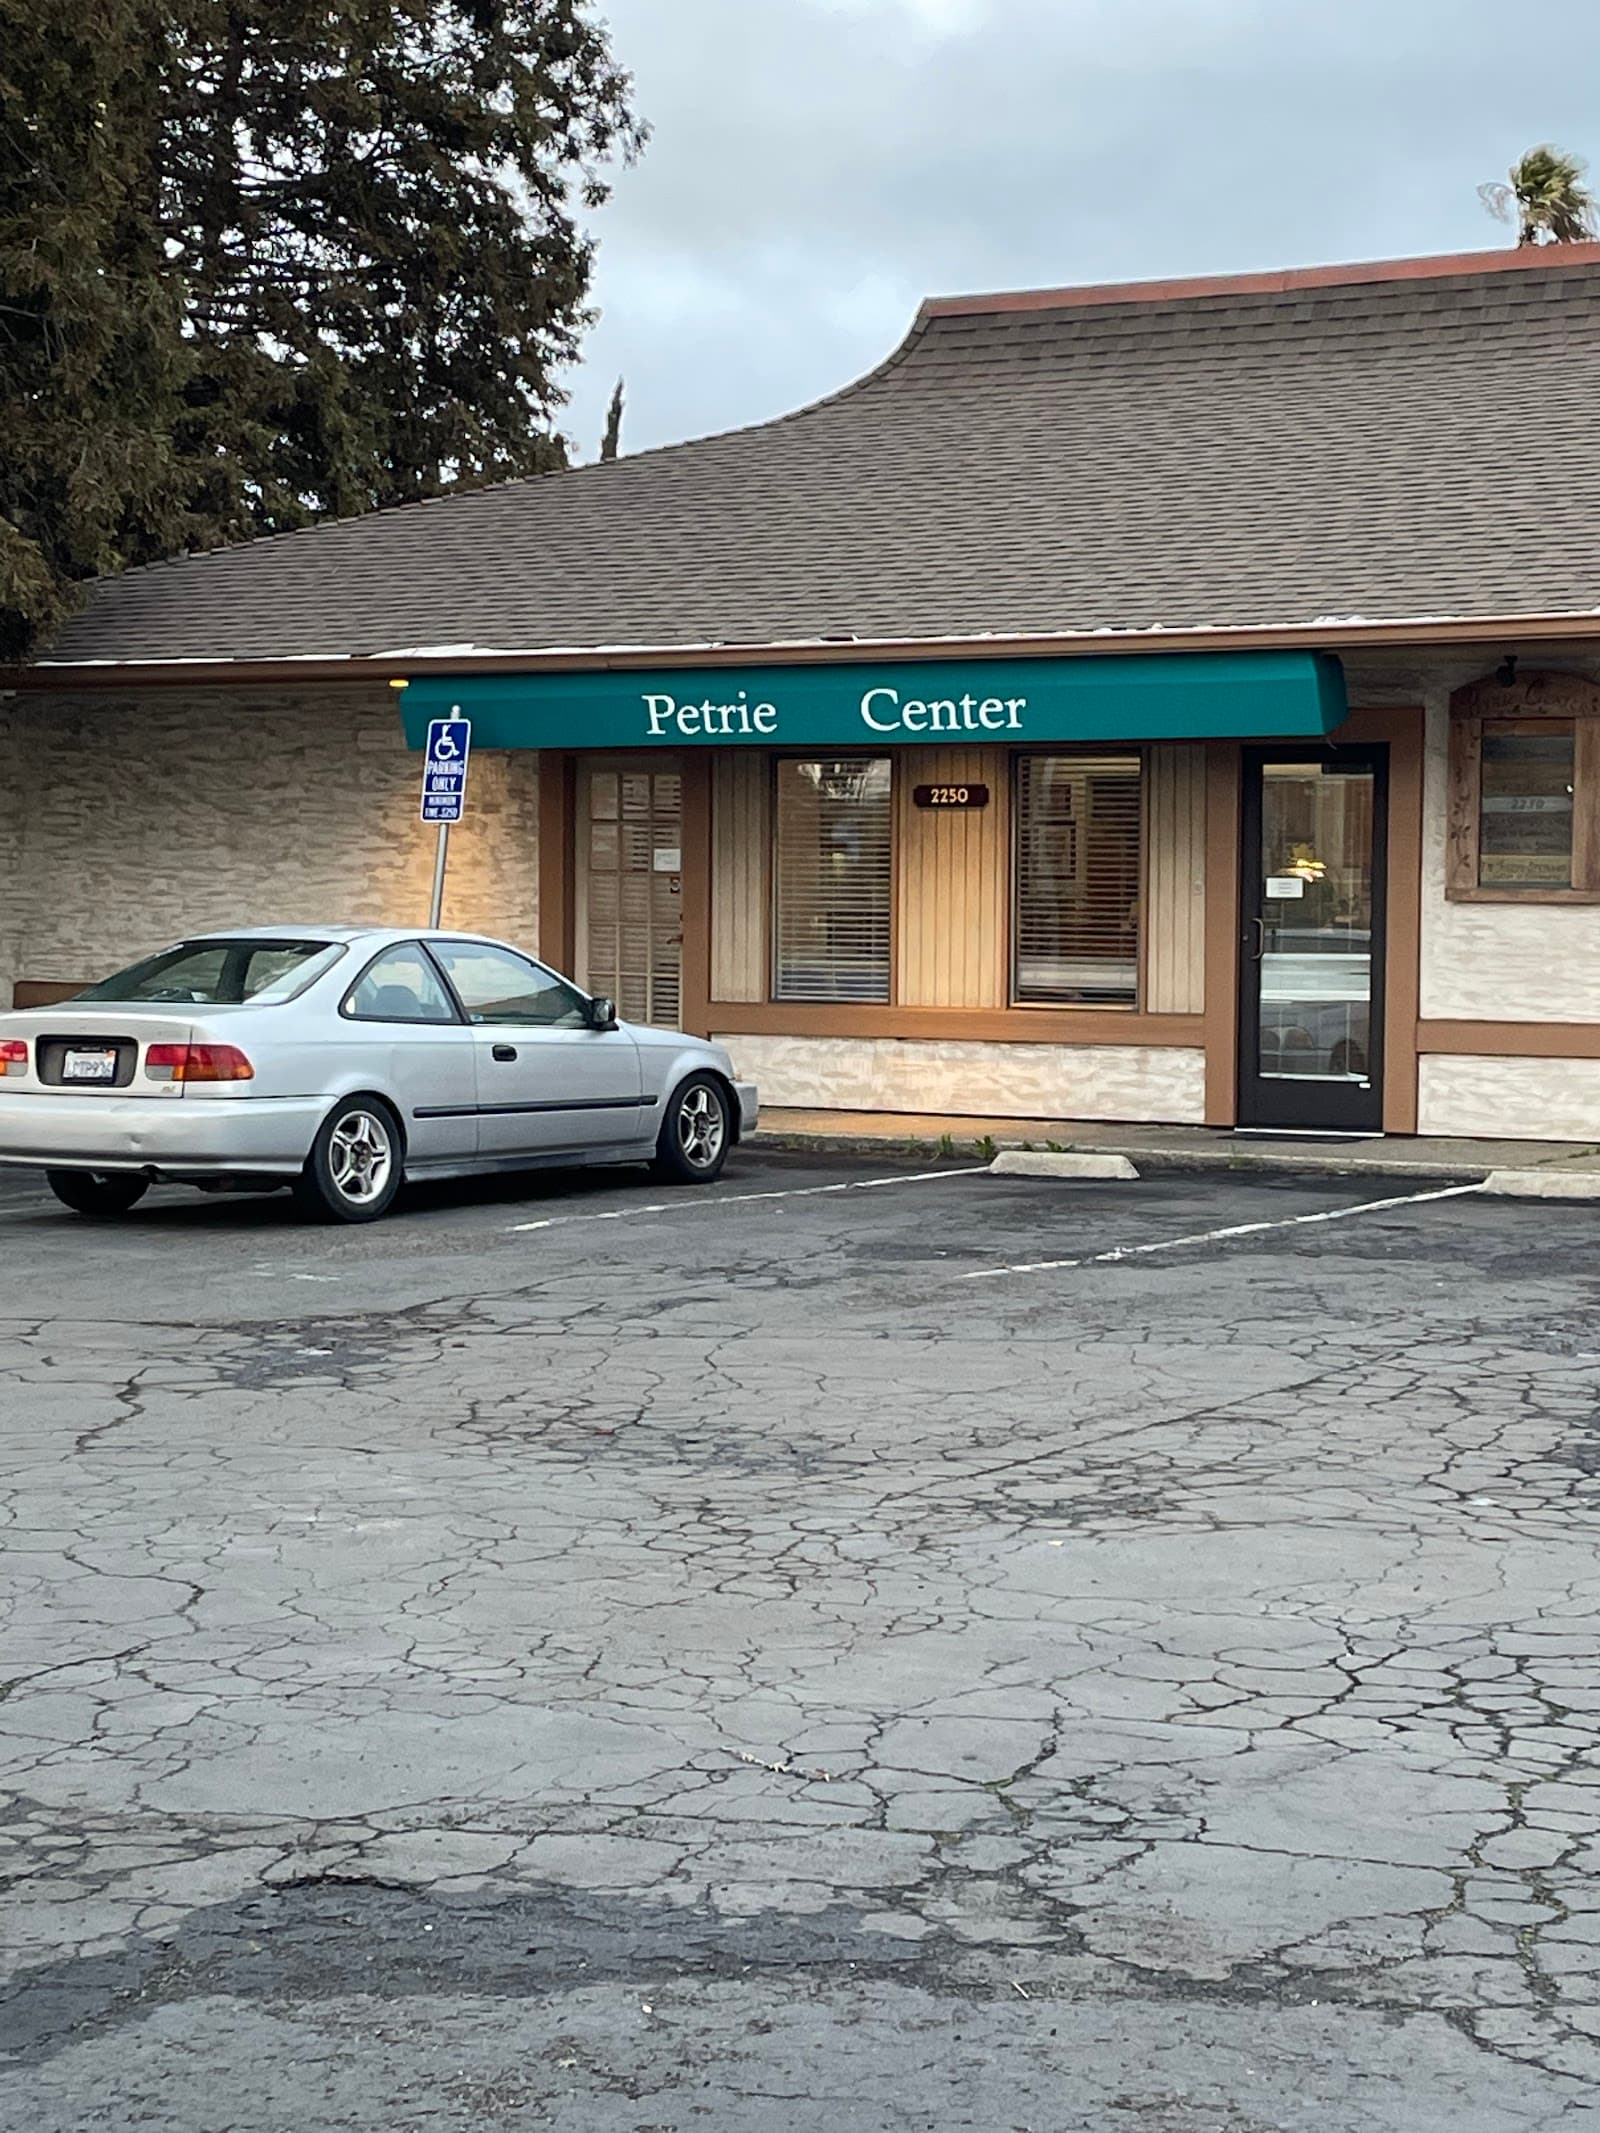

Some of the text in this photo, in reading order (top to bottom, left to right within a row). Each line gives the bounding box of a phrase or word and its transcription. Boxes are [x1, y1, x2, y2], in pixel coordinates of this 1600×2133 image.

[642, 688, 1027, 735] Petrie Center
[427, 760, 464, 775] PARKING
[431, 776, 457, 791] ONLY
[931, 788, 969, 803] 2250
